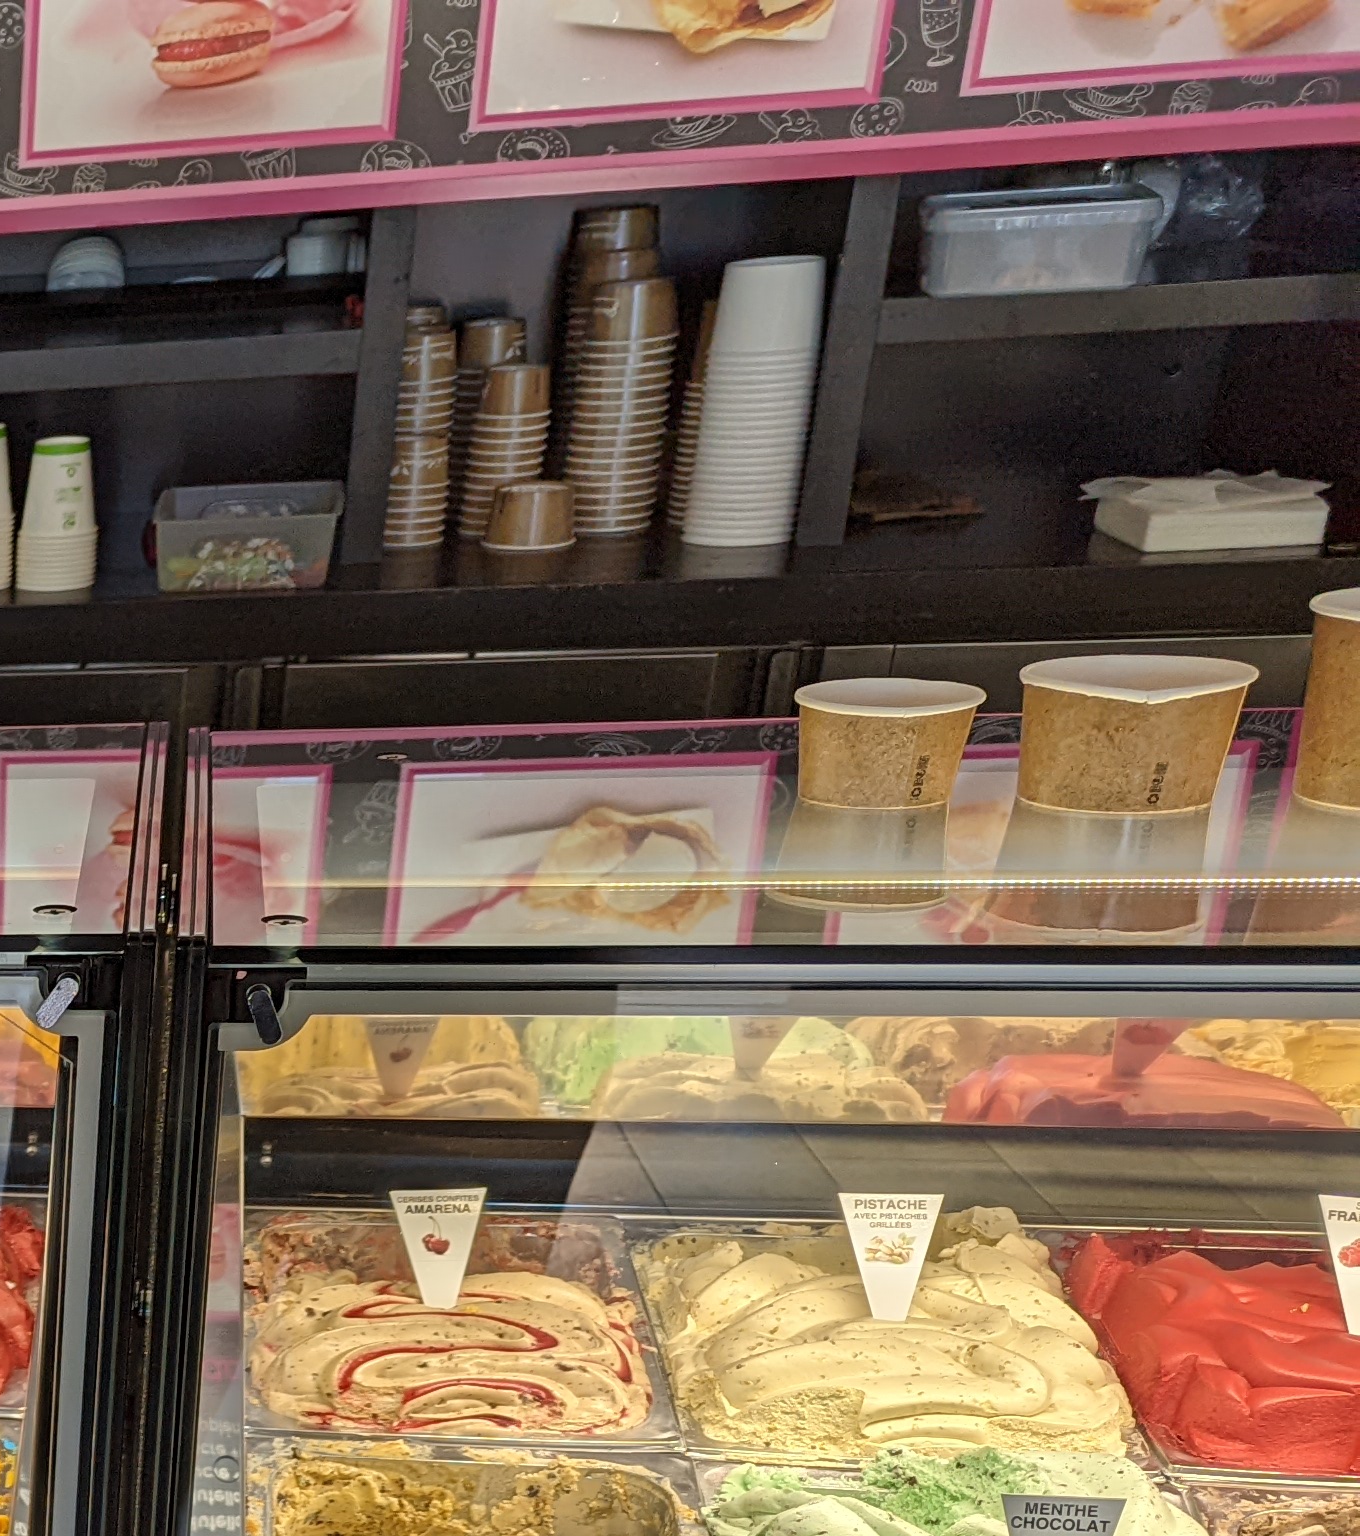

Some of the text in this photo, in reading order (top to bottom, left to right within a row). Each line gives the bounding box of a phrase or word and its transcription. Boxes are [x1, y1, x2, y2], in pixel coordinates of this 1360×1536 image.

[404, 1203, 472, 1215] AMARENA
[854, 1198, 928, 1210] PISTACHE
[853, 1212, 878, 1220] AVEC
[1328, 1209, 1360, 1222] FRA
[1024, 1502, 1099, 1518] MENTHE
[1010, 1515, 1111, 1532] CHOCOLAT
